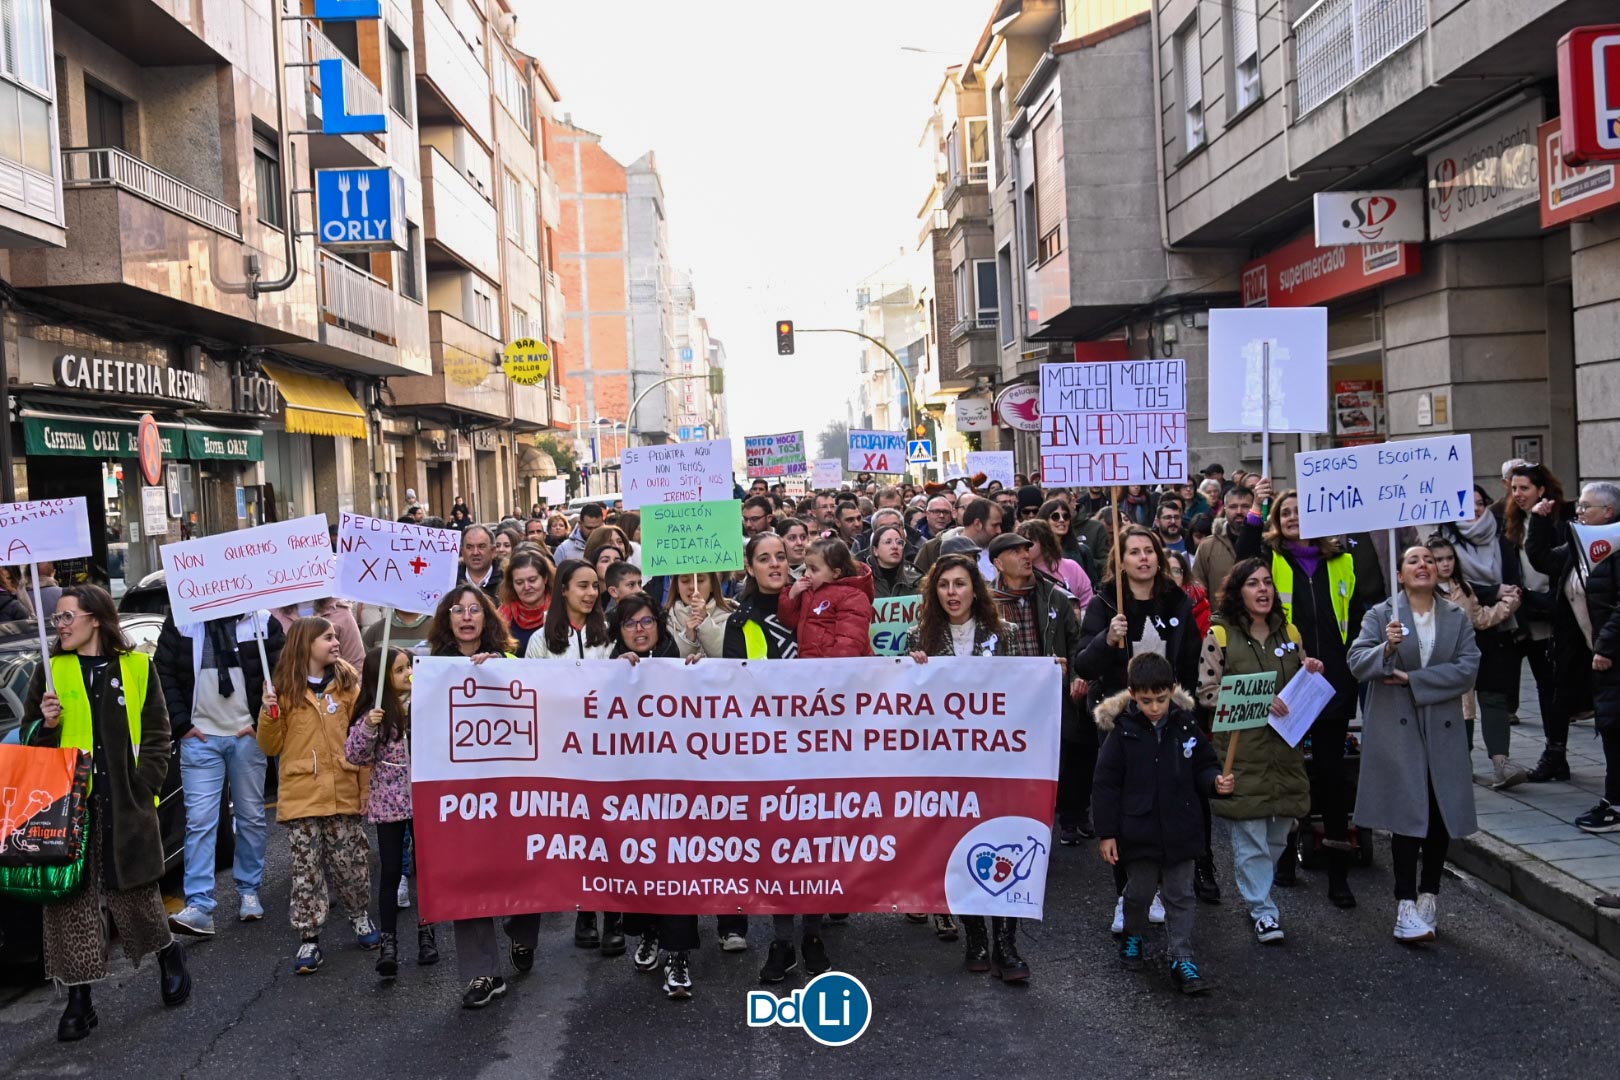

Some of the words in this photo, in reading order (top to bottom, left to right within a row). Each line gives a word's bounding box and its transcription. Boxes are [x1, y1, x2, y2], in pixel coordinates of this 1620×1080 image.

[324, 219, 387, 241] ORLY
[1279, 247, 1346, 293] supermercado
[516, 339, 535, 349] BAR
[504, 355, 510, 363] 2
[513, 355, 524, 363] DE
[527, 353, 548, 362] MAYO
[513, 364, 540, 372] POLLOS
[61, 354, 163, 395] CAFETERIA
[511, 372, 543, 384] ASADOS
[1049, 365, 1107, 387] MOITO
[1121, 361, 1178, 386] MOITA
[684, 362, 694, 413] HOTEL
[1060, 387, 1107, 410] MOCO
[1134, 386, 1169, 408] TOS
[1040, 414, 1079, 447] SEN
[1086, 412, 1187, 446] PEDIATRA
[92, 430, 120, 451] ORLY
[227, 439, 248, 455] ORLY
[745, 437, 773, 446] MOITO
[776, 434, 796, 444] MOCO
[746, 448, 773, 457] MOITA
[779, 443, 801, 454] TOSE
[849, 433, 906, 450] PEDIATRAS
[625, 451, 639, 465] SE
[648, 448, 685, 462] PEDIATRA
[694, 442, 713, 457] AQUÍ
[748, 458, 764, 467] SEN
[863, 453, 888, 471] XA
[1041, 452, 1129, 482] ESTAMOS
[1142, 445, 1182, 480] NÓS
[1302, 454, 1358, 477] SERGAS
[1447, 445, 1459, 461] A
[655, 464, 671, 474] NON
[678, 462, 706, 473] TEMOS,
[748, 465, 785, 477] ESTAMOS
[787, 462, 807, 474] HOXE
[630, 478, 638, 491] A
[646, 478, 670, 488] OUTRO
[709, 475, 724, 484] NOS
[663, 486, 703, 502] IREMOS!
[1306, 485, 1364, 513] LIMIA
[1378, 474, 1409, 501] ESTÁ
[1420, 477, 1435, 494] EN
[654, 504, 712, 520] SOLUCIÓN
[342, 513, 457, 542] PEDIATRAS
[667, 523, 692, 534] PARA
[695, 523, 704, 531] A
[0, 538, 32, 562] A
[173, 551, 205, 572] NON
[224, 539, 278, 561] QUEREMOS
[287, 531, 330, 550] PARCHES
[341, 535, 373, 554] NA
[390, 538, 459, 554] LIMIA
[656, 533, 722, 550] PEDIATRÍA
[358, 557, 403, 583] XA
[651, 556, 668, 567] NA
[178, 574, 253, 600] QUEREMOS
[1234, 679, 1275, 695] PALABRAS
[583, 690, 599, 719] É
[607, 696, 629, 719] A
[637, 694, 743, 719] CONTA
[750, 687, 846, 717] ATRÁS
[856, 692, 935, 716] PARA
[943, 692, 1006, 721] QUE
[455, 719, 533, 747] 2024
[561, 731, 583, 754] A
[592, 731, 678, 756] LIMIA
[686, 730, 788, 760] QUEDE
[797, 729, 852, 753] SEN
[864, 728, 1028, 753] PEDIATRAS
[439, 791, 498, 822] POR
[509, 790, 590, 820] UNHA
[601, 793, 748, 821] SANIDADE
[759, 785, 883, 822] PÚBLICA
[894, 790, 981, 819] DIGNA
[27, 825, 67, 840] Miguel
[526, 833, 609, 863] PARA
[620, 837, 657, 864] OS
[667, 837, 761, 864] NOSOS
[771, 834, 896, 864] CATIVOS
[582, 876, 638, 895] LOITA
[644, 878, 750, 896] PEDIATRAS
[755, 879, 784, 895] NA
[789, 879, 844, 896] LIMIA
